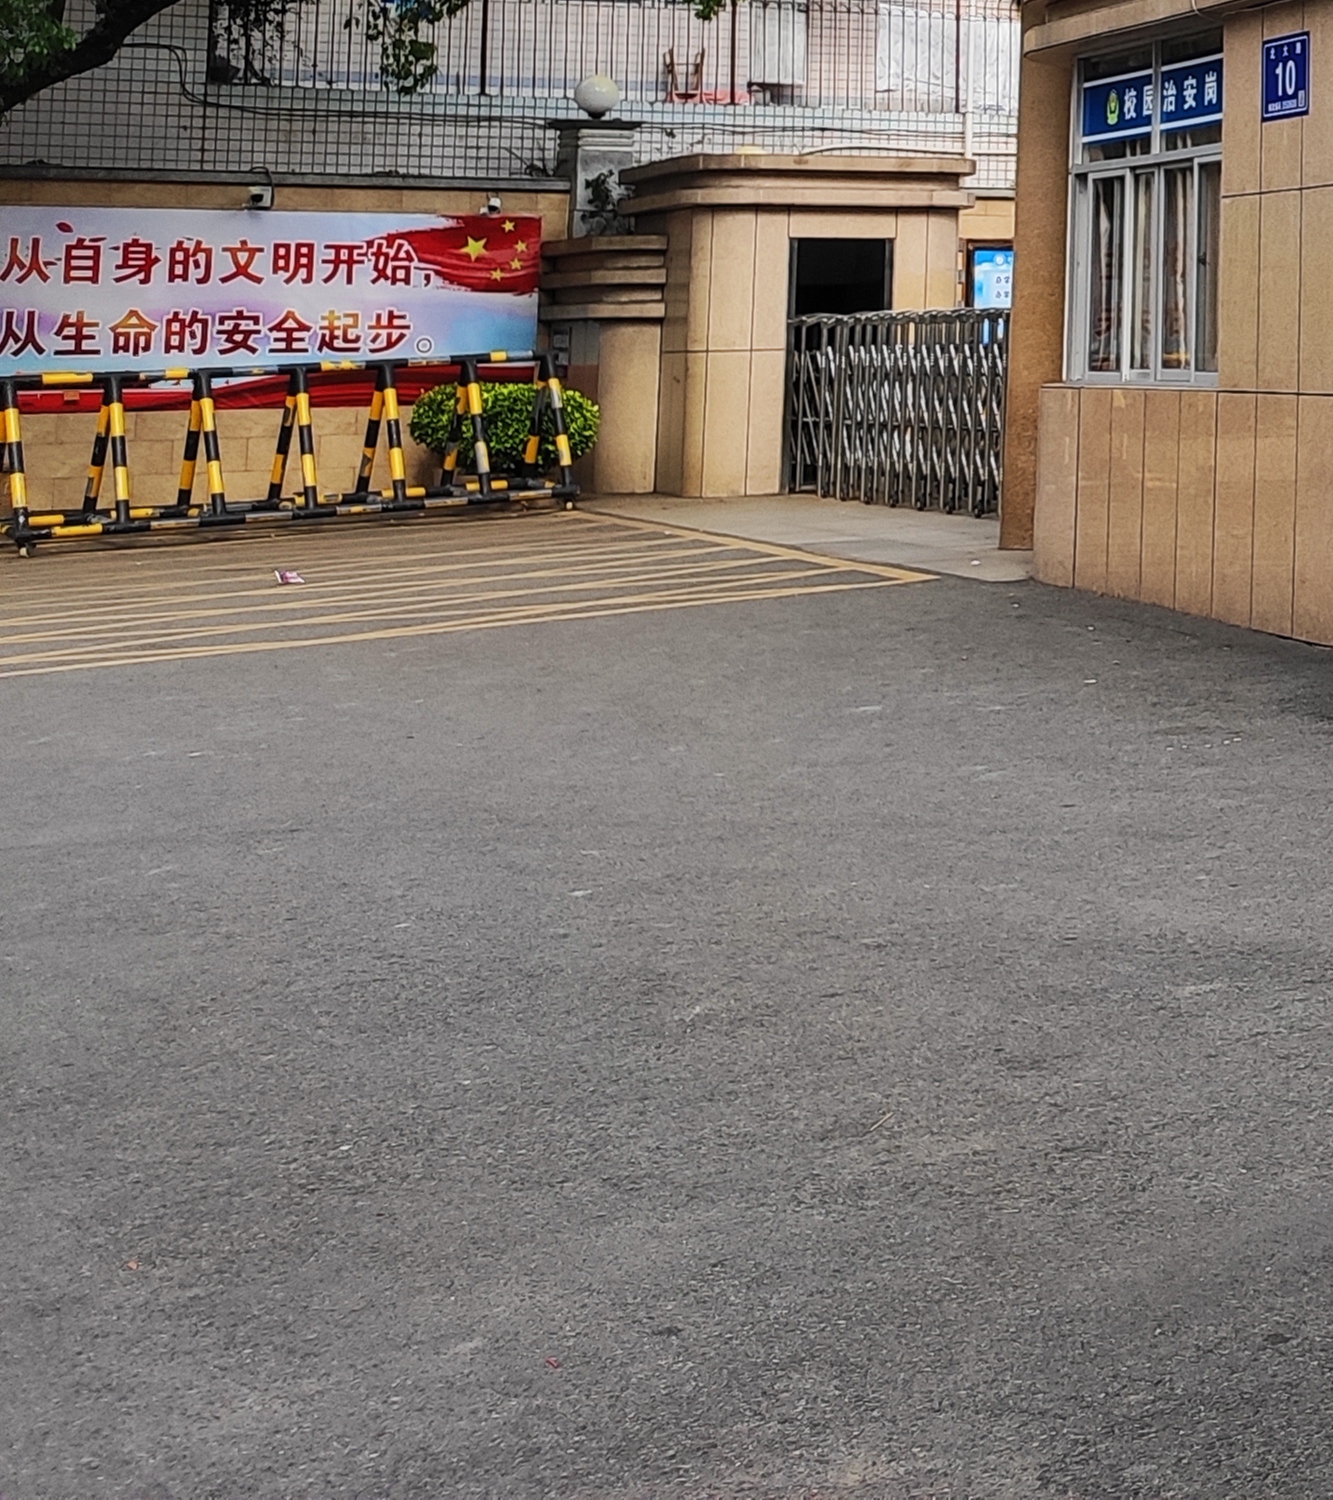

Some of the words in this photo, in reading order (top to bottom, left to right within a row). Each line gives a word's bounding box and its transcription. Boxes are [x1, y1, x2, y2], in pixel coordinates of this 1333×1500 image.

[1123, 70, 1218, 121] 校园治安岗
[1275, 60, 1297, 97] 10
[0, 236, 435, 288] 从自身的文明开始，
[0, 308, 434, 356] 从生命的安全起步。
